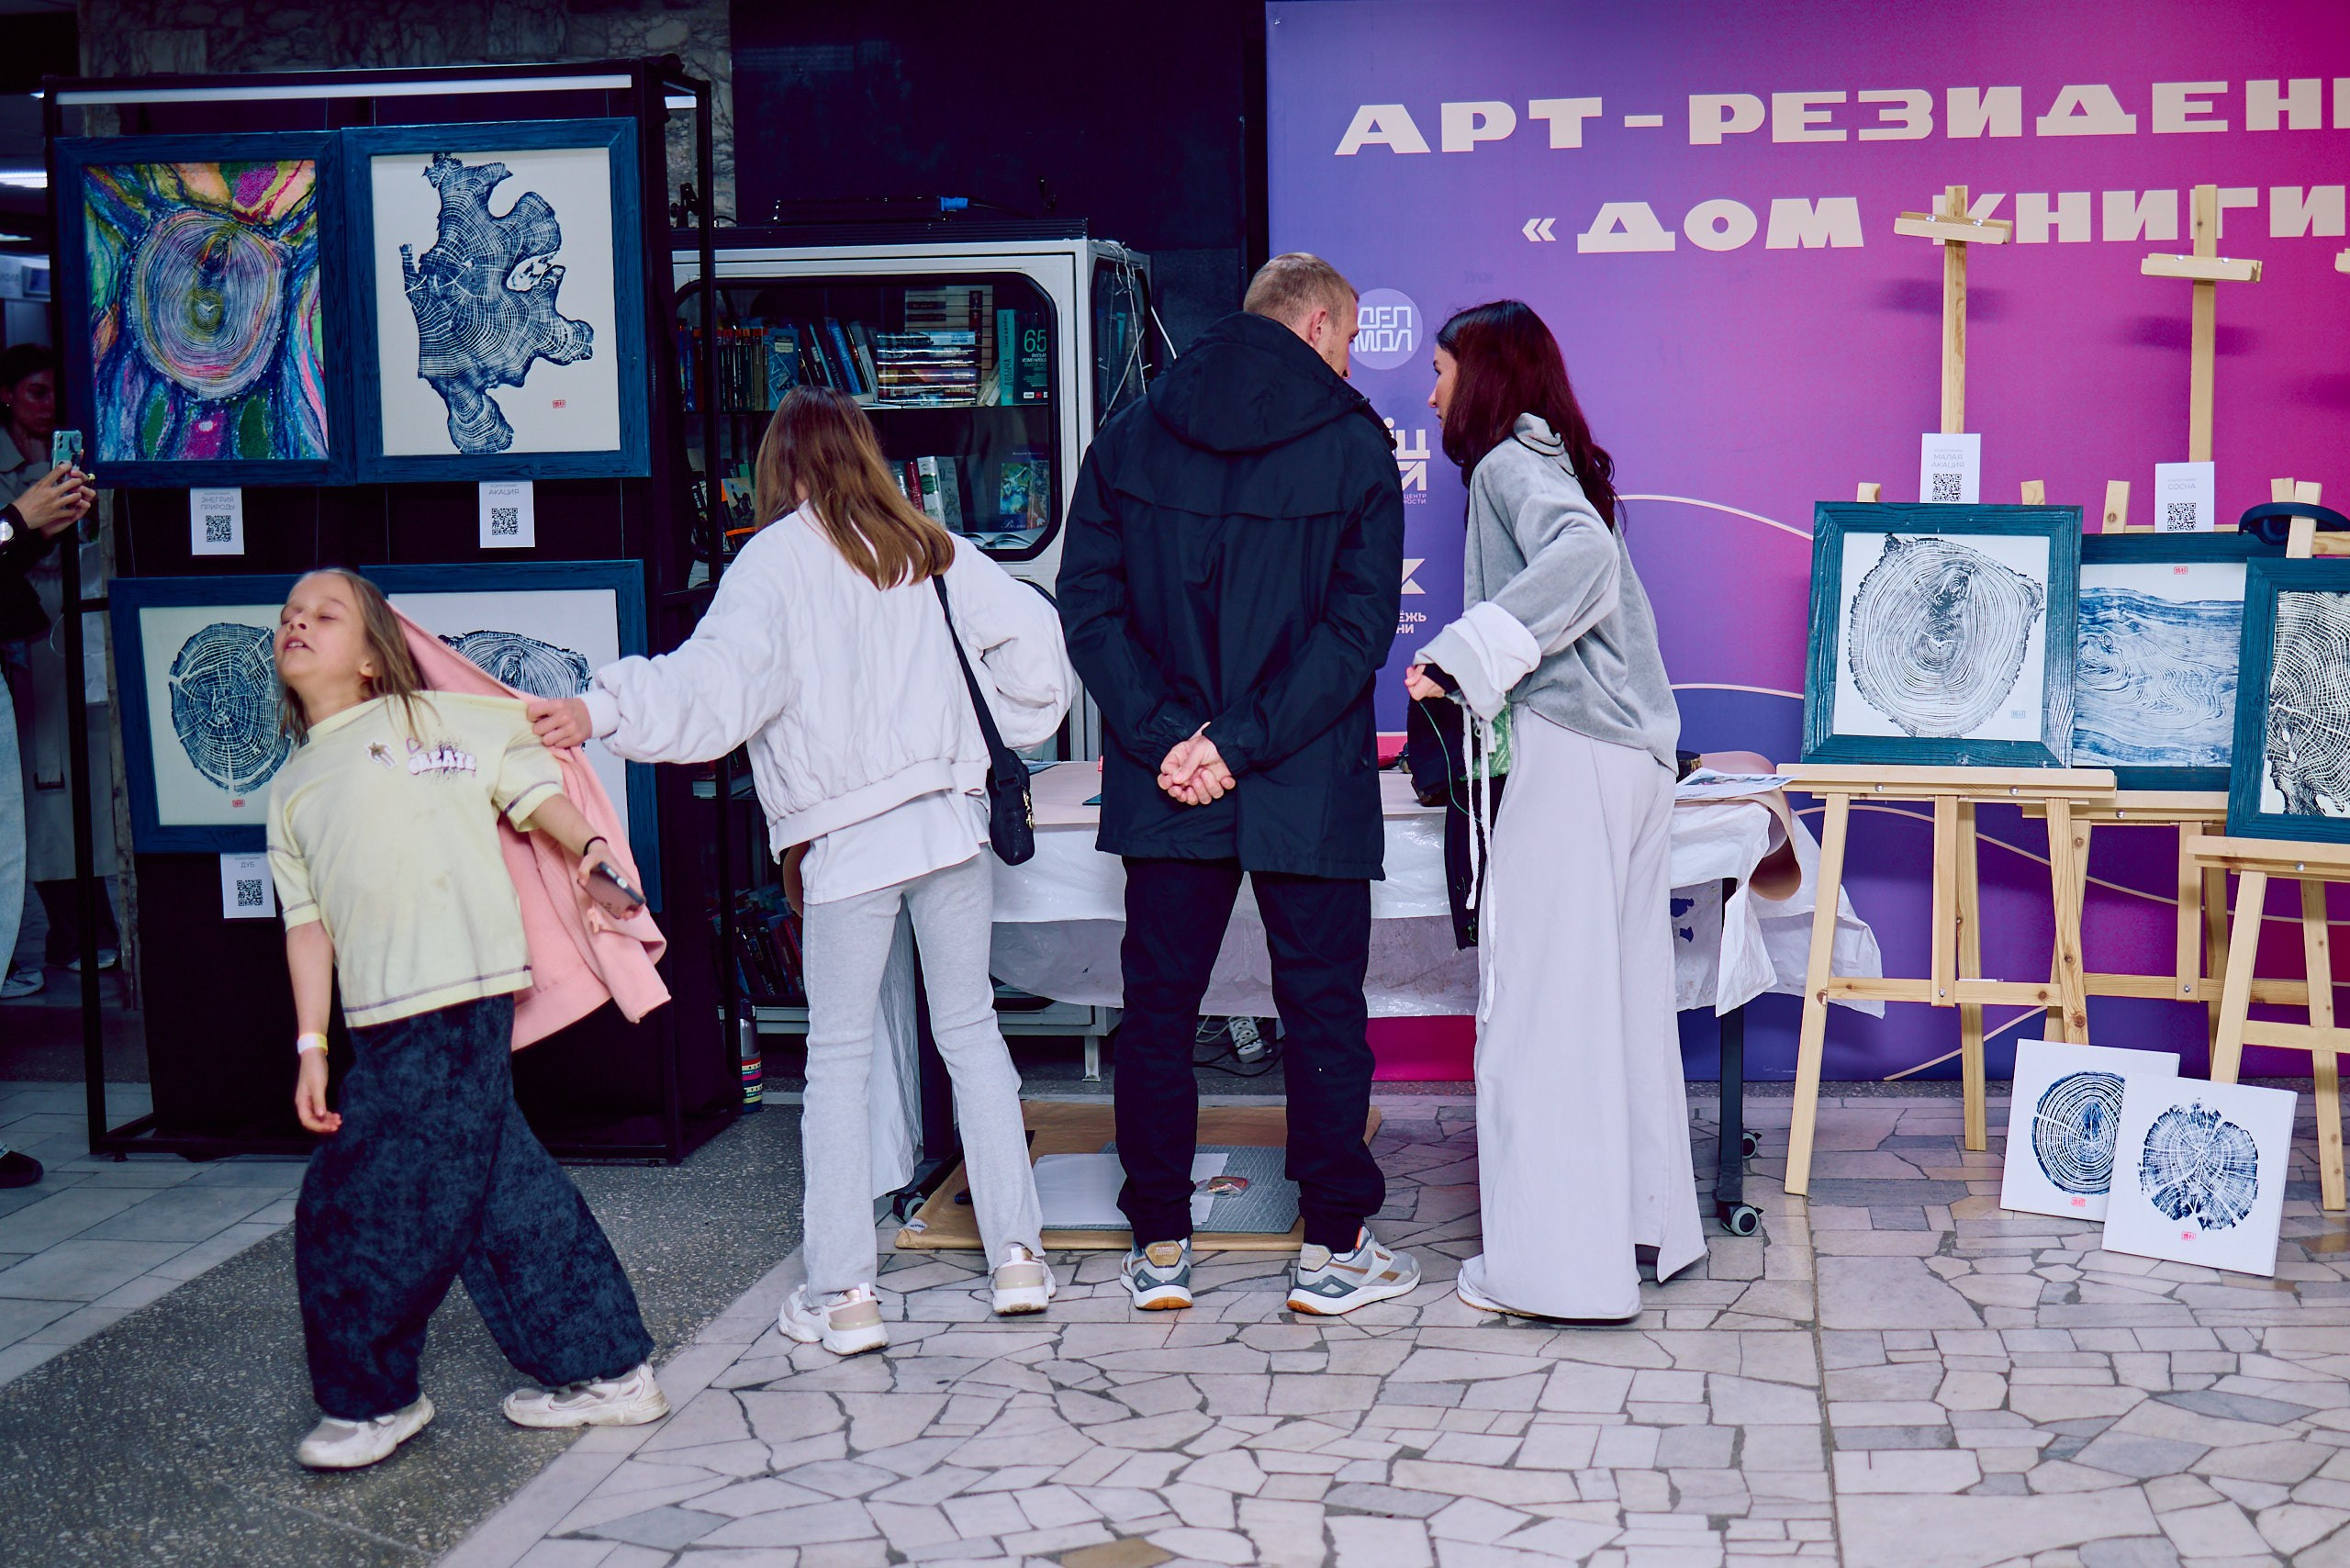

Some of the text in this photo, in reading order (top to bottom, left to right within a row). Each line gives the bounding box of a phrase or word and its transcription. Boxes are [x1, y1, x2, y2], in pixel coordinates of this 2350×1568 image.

[1335, 77, 2350, 156] АРТ-РЕЗИДЕН
[1004, 358, 1013, 386] ДОБЫЧА
[1395, 623, 1415, 634] НИ
[1399, 610, 1427, 622] ЁЖЬ
[408, 748, 477, 776] CREATE
